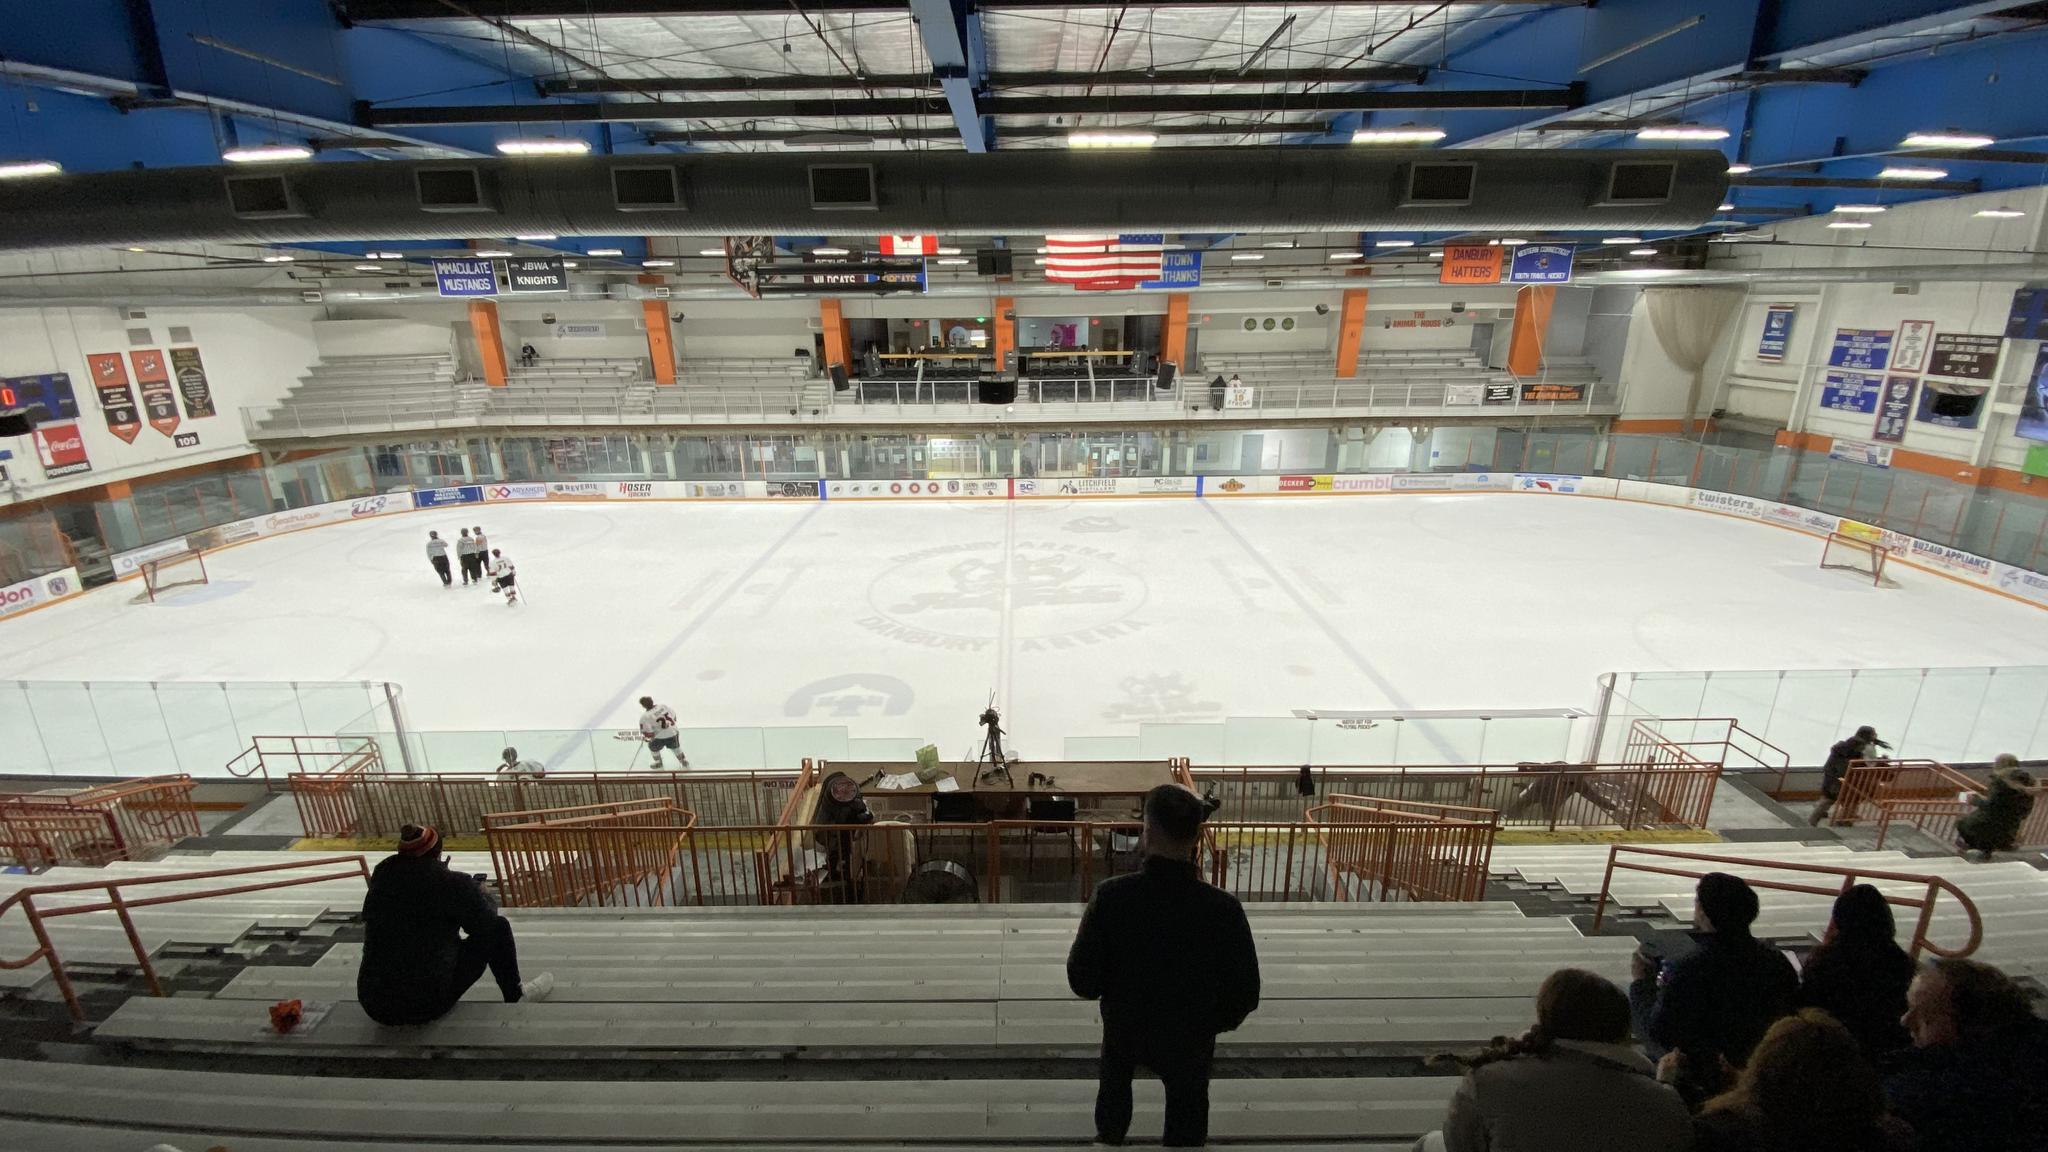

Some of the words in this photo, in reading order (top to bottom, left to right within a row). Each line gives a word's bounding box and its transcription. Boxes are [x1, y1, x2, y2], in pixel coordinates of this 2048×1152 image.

[1453, 249, 1495, 259] DANBURY
[437, 261, 490, 274] IMMACULATE
[522, 262, 549, 271] JBWA
[1451, 266, 1491, 278] HATTERS
[517, 276, 559, 285] KNIGHTS
[1161, 270, 1199, 282] THAWKS
[444, 278, 491, 291] MUSTANGS
[1414, 311, 1425, 319] THE
[1393, 319, 1416, 328] ANIMAL
[1421, 319, 1441, 328] HOUSE
[50, 437, 81, 453] Coca-Cola
[178, 435, 197, 447] 109
[46, 462, 90, 477] POWERADE
[565, 483, 598, 492] REVERIE
[619, 482, 651, 494] HOSER
[1079, 479, 1116, 487] LITCHFIELD
[1280, 479, 1304, 487] DECKER
[1334, 477, 1391, 490] crumbl
[1699, 491, 1754, 510] twisters
[1913, 540, 1943, 556] BUZAID
[1945, 549, 1991, 571] APPLIANCE
[856, 615, 993, 653] DANBURY
[1019, 619, 1152, 652] ARENA
[763, 780, 777, 788] NO
